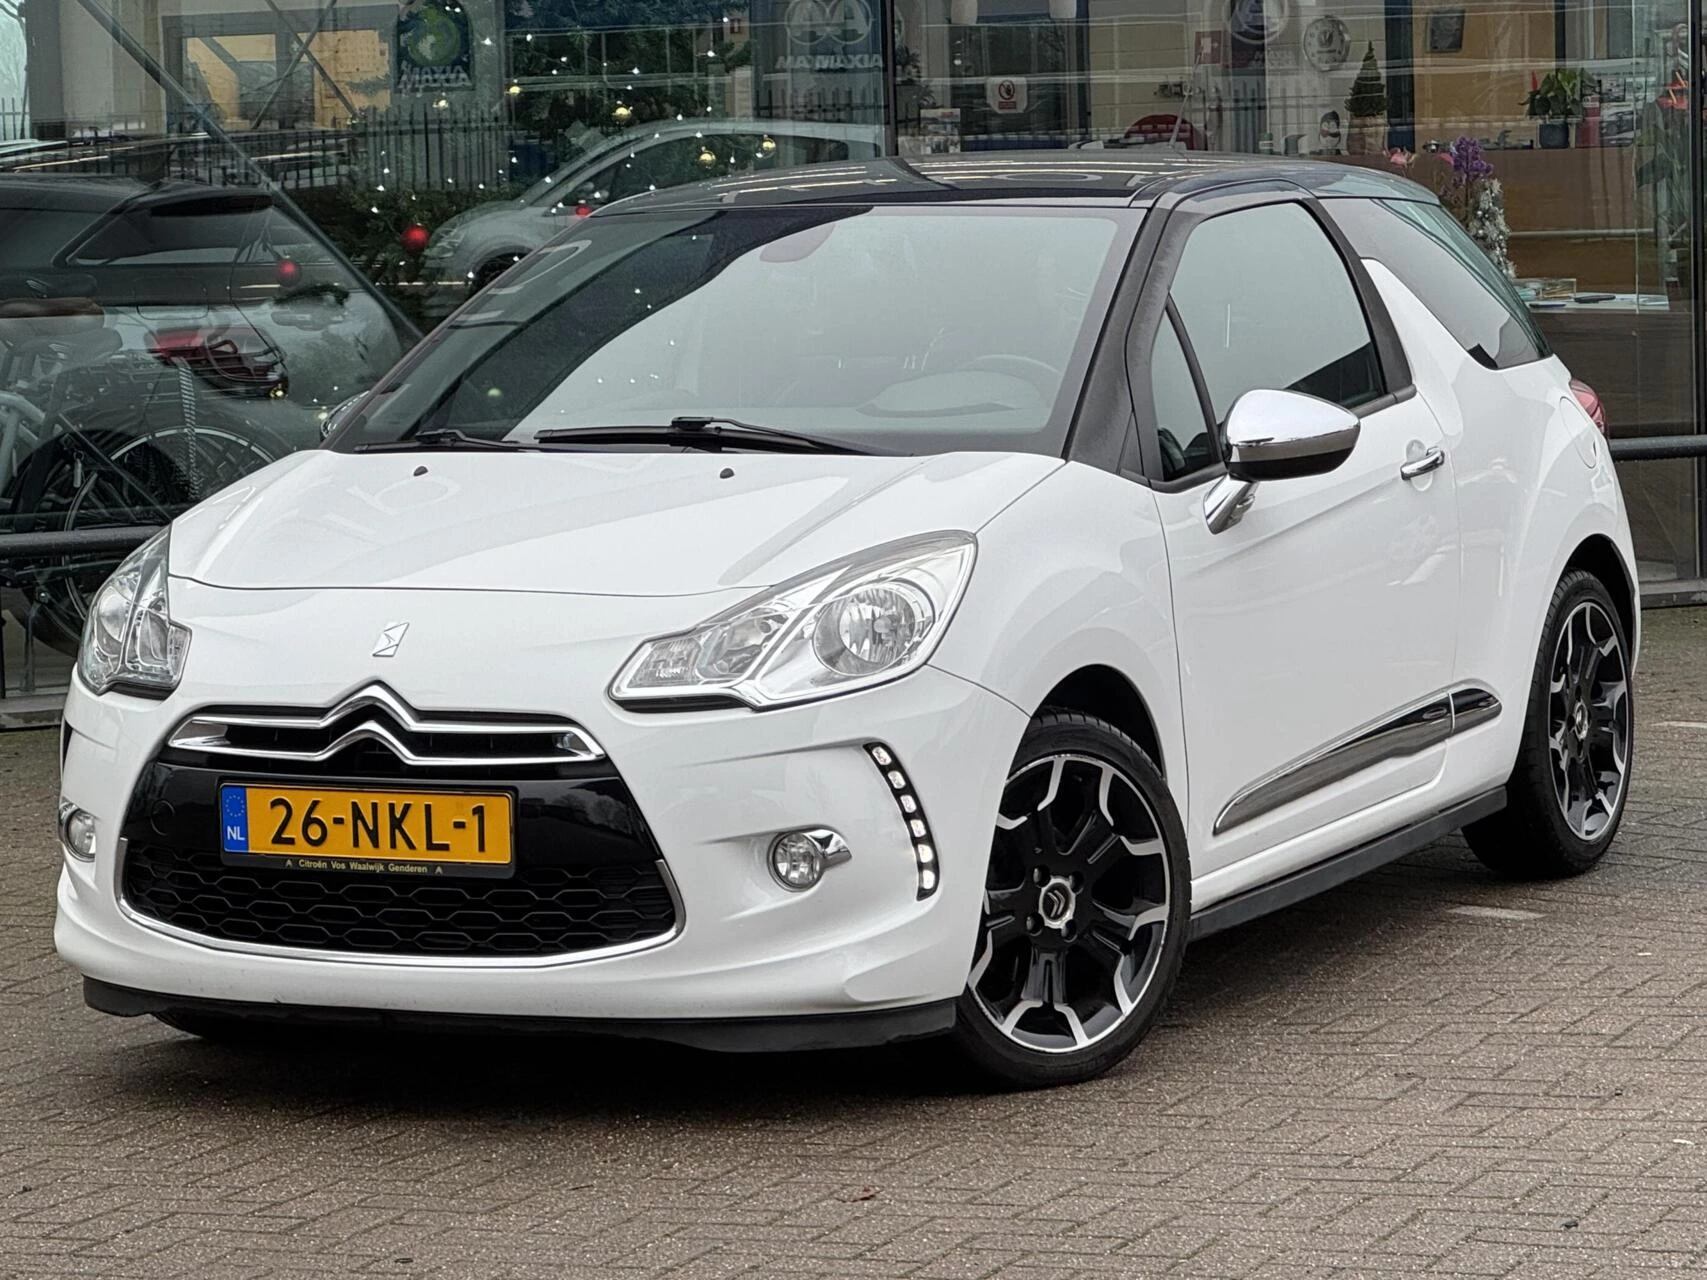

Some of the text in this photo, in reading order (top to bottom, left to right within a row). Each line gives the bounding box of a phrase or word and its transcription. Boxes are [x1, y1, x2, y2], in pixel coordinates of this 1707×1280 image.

[270, 797, 486, 852] 26-NKL-1
[227, 825, 246, 841] NL
[298, 858, 428, 873] Citroën Vos Waalwijk Genderen
